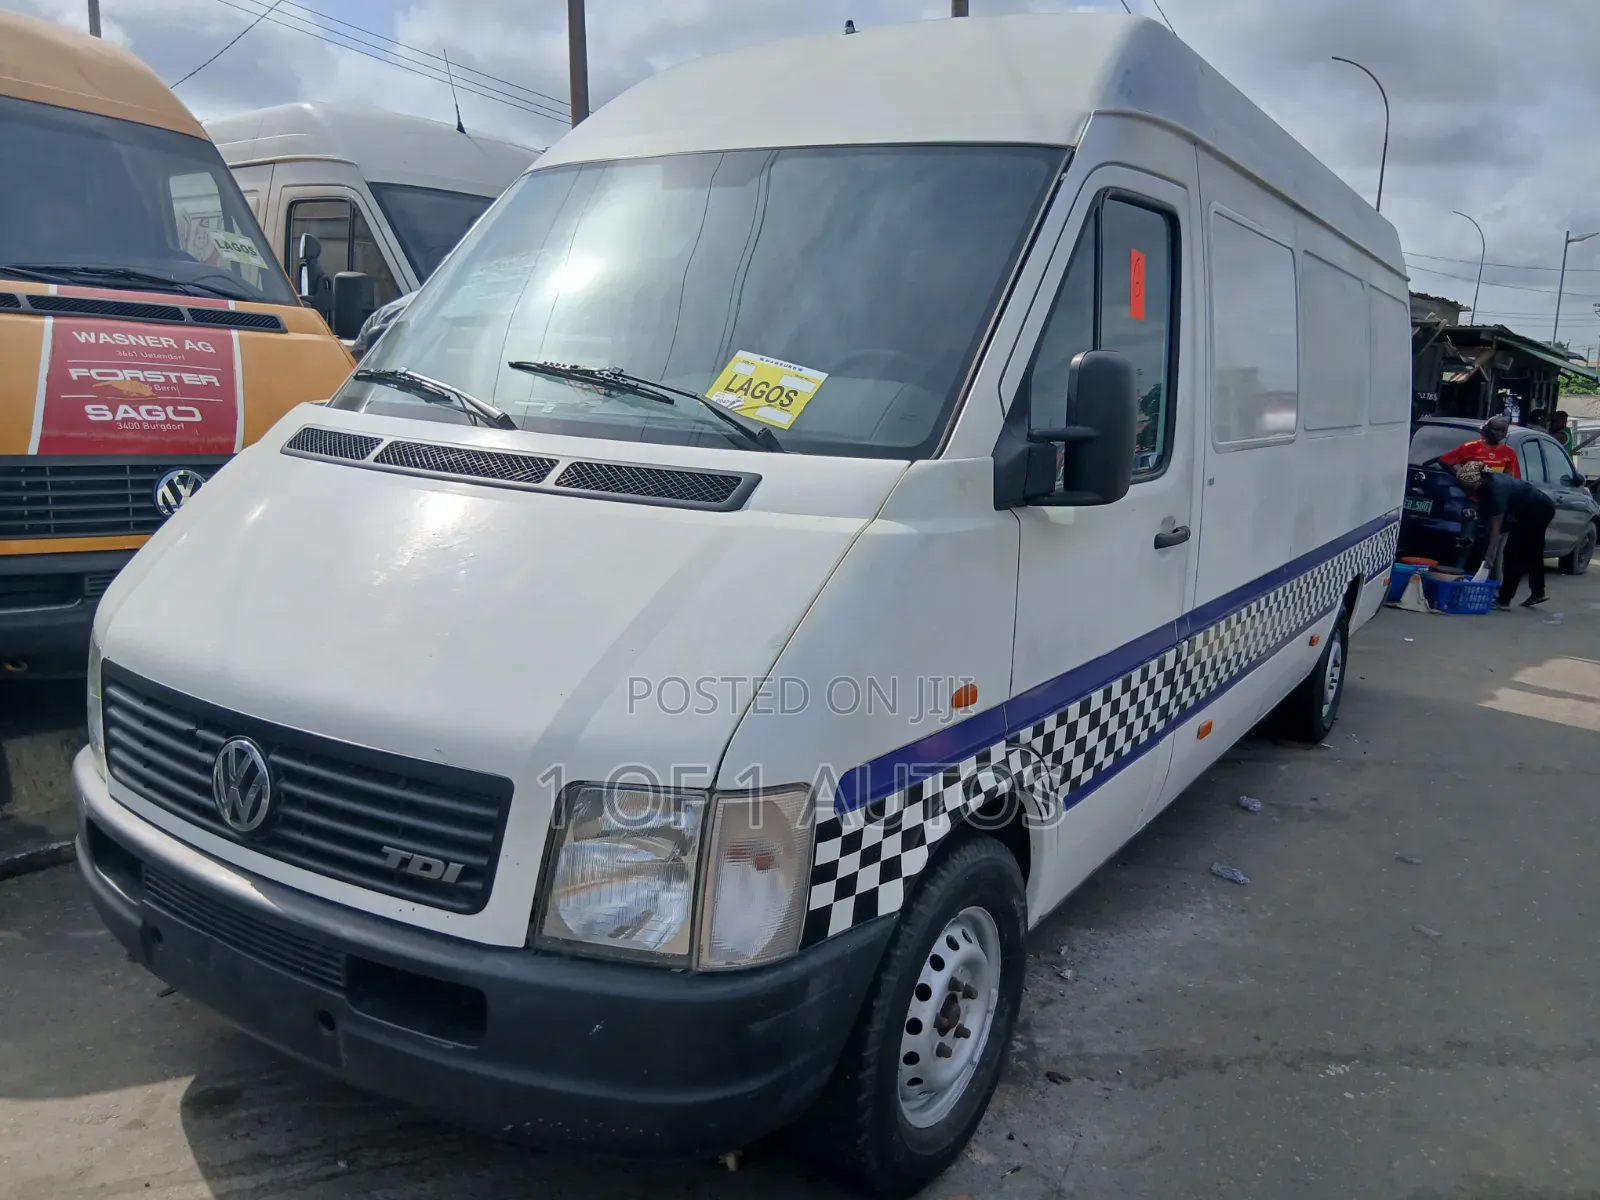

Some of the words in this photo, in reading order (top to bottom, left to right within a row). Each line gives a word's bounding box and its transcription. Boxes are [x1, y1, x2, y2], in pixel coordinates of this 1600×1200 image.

[214, 239, 258, 257] LAGOS
[72, 331, 179, 349] WASNER
[184, 339, 216, 353] AG
[115, 350, 138, 358] 3661
[140, 351, 186, 361] Uetendorf
[68, 368, 220, 387] FORSTER
[154, 384, 177, 392] Bern
[723, 374, 799, 408] LAGOS
[84, 404, 203, 422] SAGO
[116, 422, 141, 430] 3400
[142, 422, 185, 432] Burgdorf
[381, 845, 465, 884] TDI
